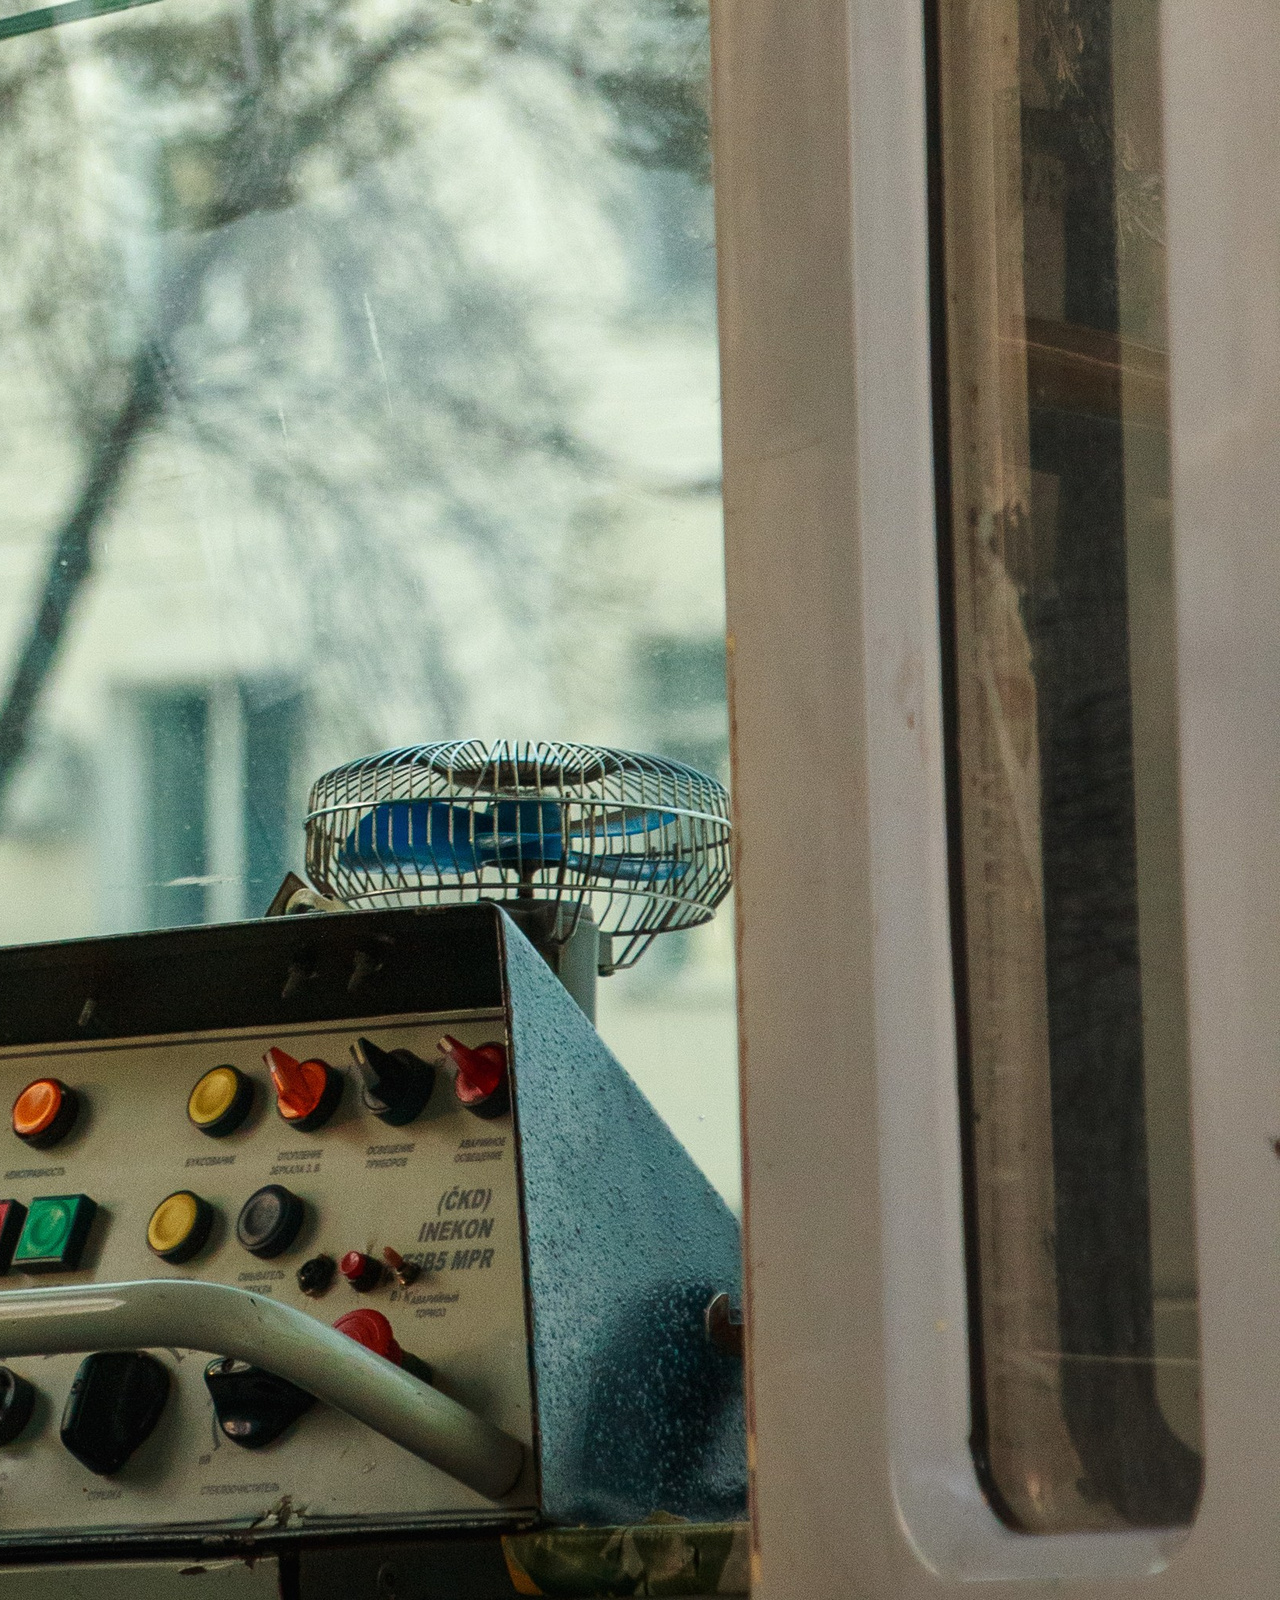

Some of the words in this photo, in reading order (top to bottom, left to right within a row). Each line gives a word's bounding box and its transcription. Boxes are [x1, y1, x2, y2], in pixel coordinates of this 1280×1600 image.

[365, 1143, 415, 1156] ОСВЕЩЕНИЕ
[453, 1151, 503, 1163] ОСВЕЩЕНИЕ
[365, 1157, 408, 1169] ПРИБОРОВ
[437, 1186, 492, 1216] (ČKD)
[417, 1218, 494, 1242] INEKON
[450, 1248, 495, 1270] MPR
